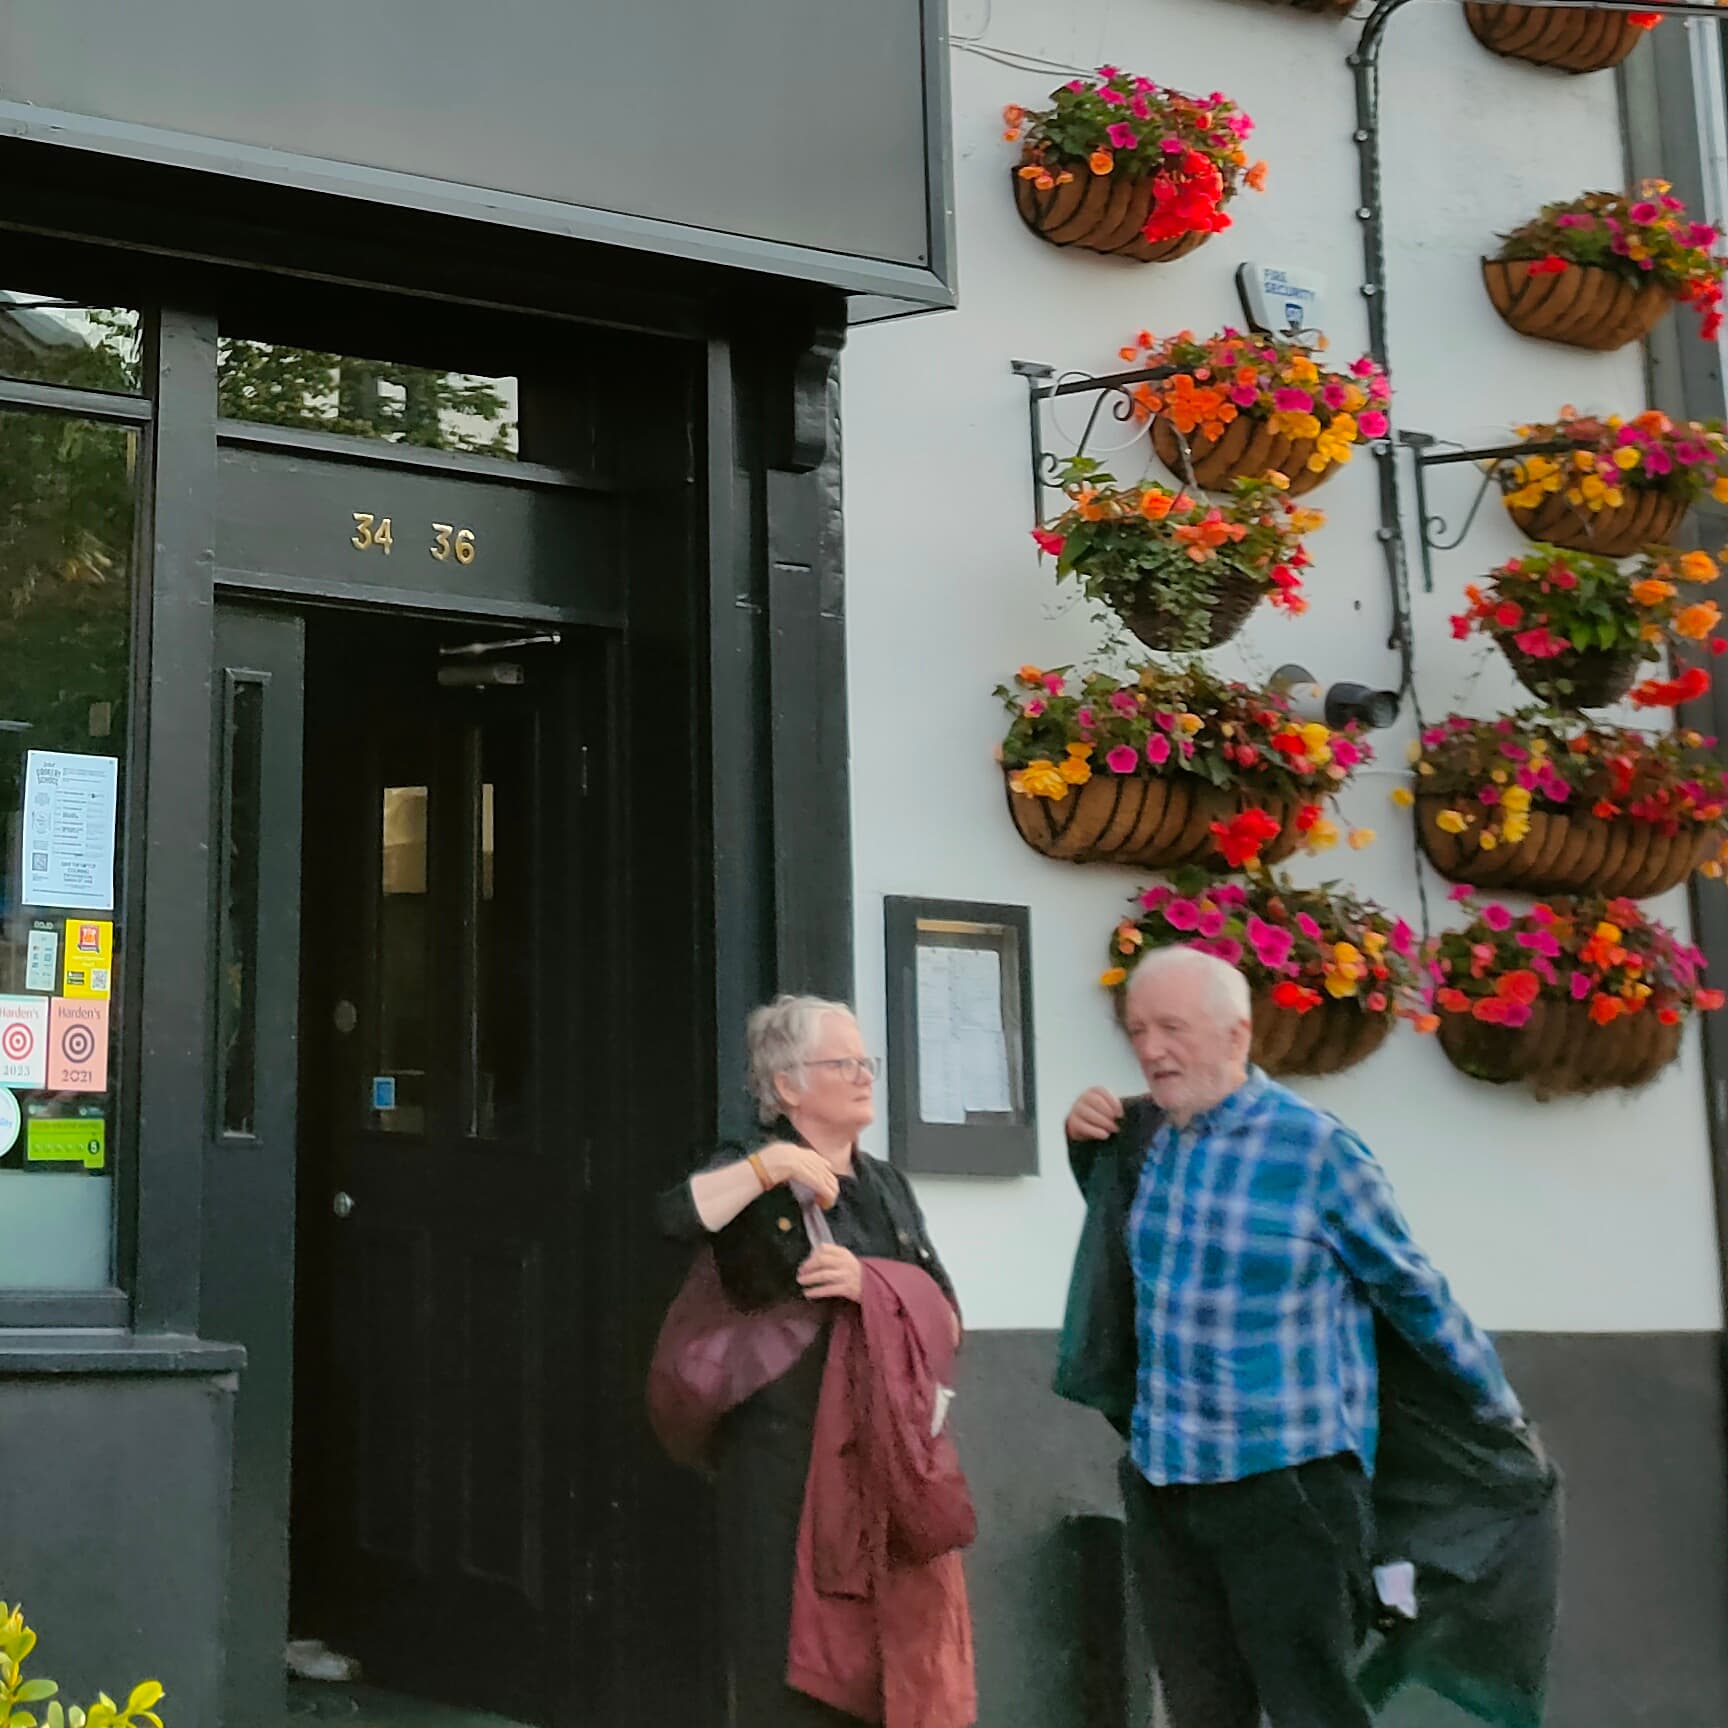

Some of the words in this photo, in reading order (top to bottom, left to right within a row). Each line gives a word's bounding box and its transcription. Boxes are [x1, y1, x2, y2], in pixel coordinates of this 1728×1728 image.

[1264, 268, 1288, 283] FIRE
[1264, 282, 1315, 300] SECURITY
[351, 512, 393, 555] 34
[430, 523, 475, 565] 36
[0, 1006, 39, 1020] Harden's
[58, 1005, 100, 1020] Harden's
[62, 1069, 93, 1083] 2021
